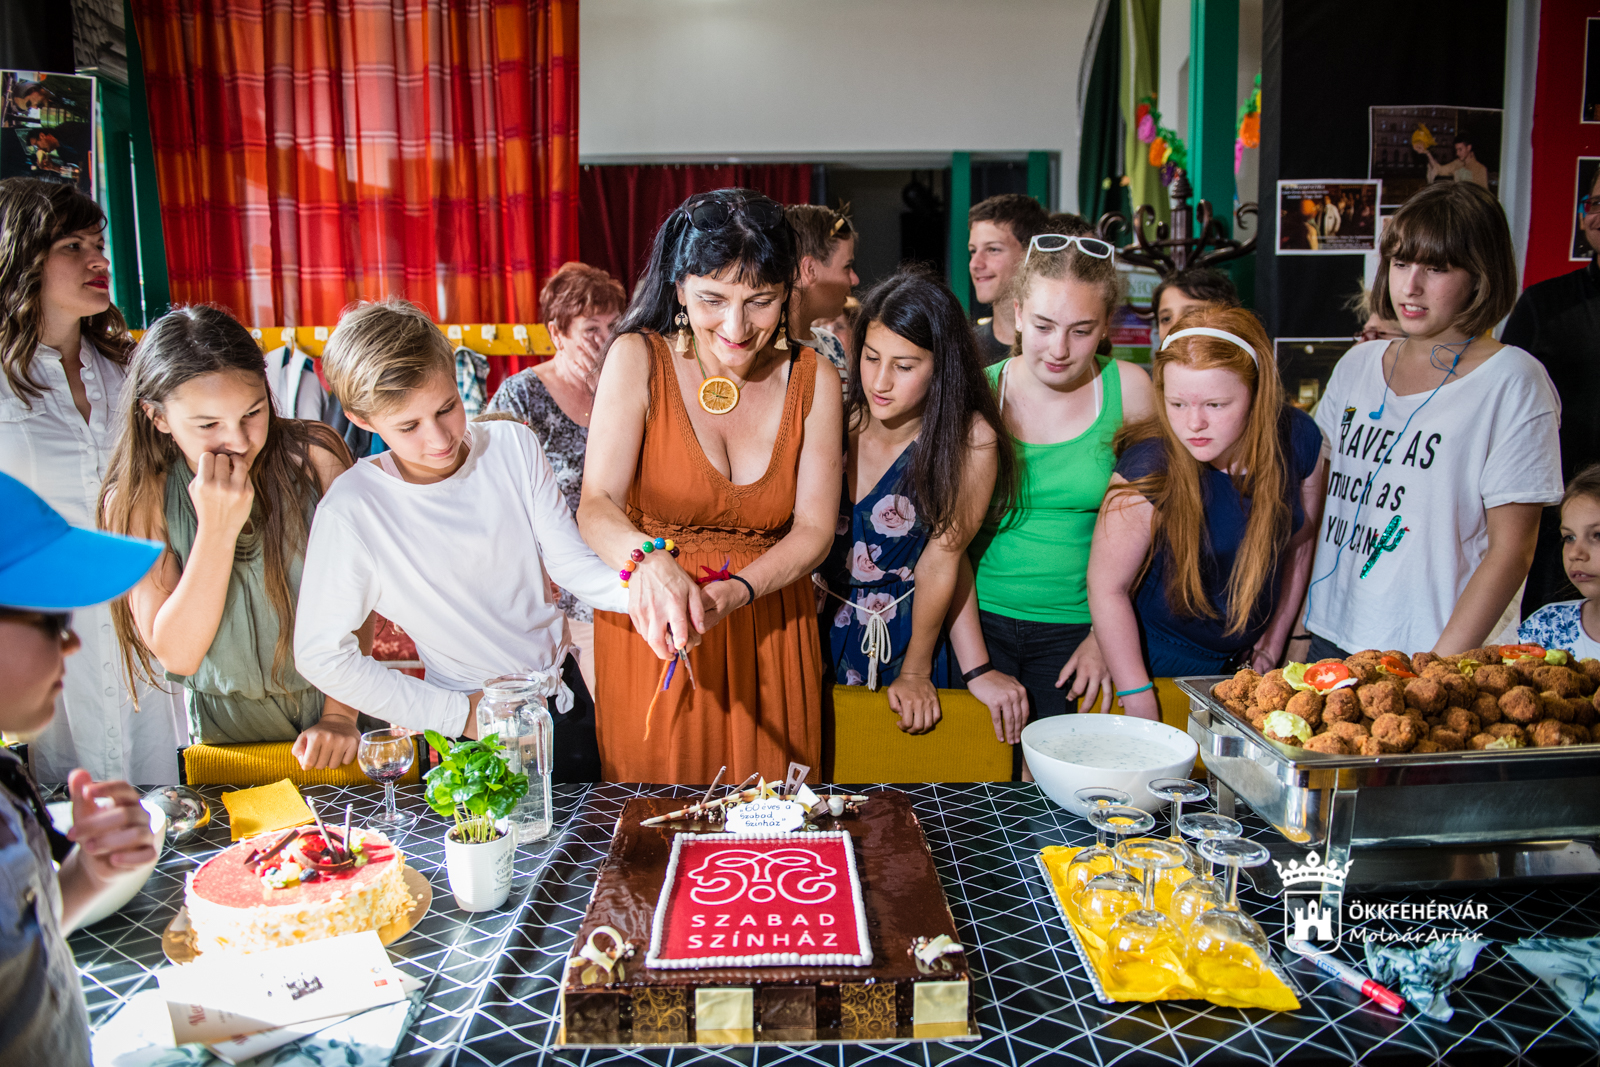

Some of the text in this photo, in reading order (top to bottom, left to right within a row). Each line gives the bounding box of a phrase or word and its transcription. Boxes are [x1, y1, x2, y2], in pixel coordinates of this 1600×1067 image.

[1401, 430, 1442, 470] AS
[1375, 482, 1406, 512] as
[691, 913, 835, 928] SZABAD
[687, 930, 839, 949] SZÍNHÁZ
